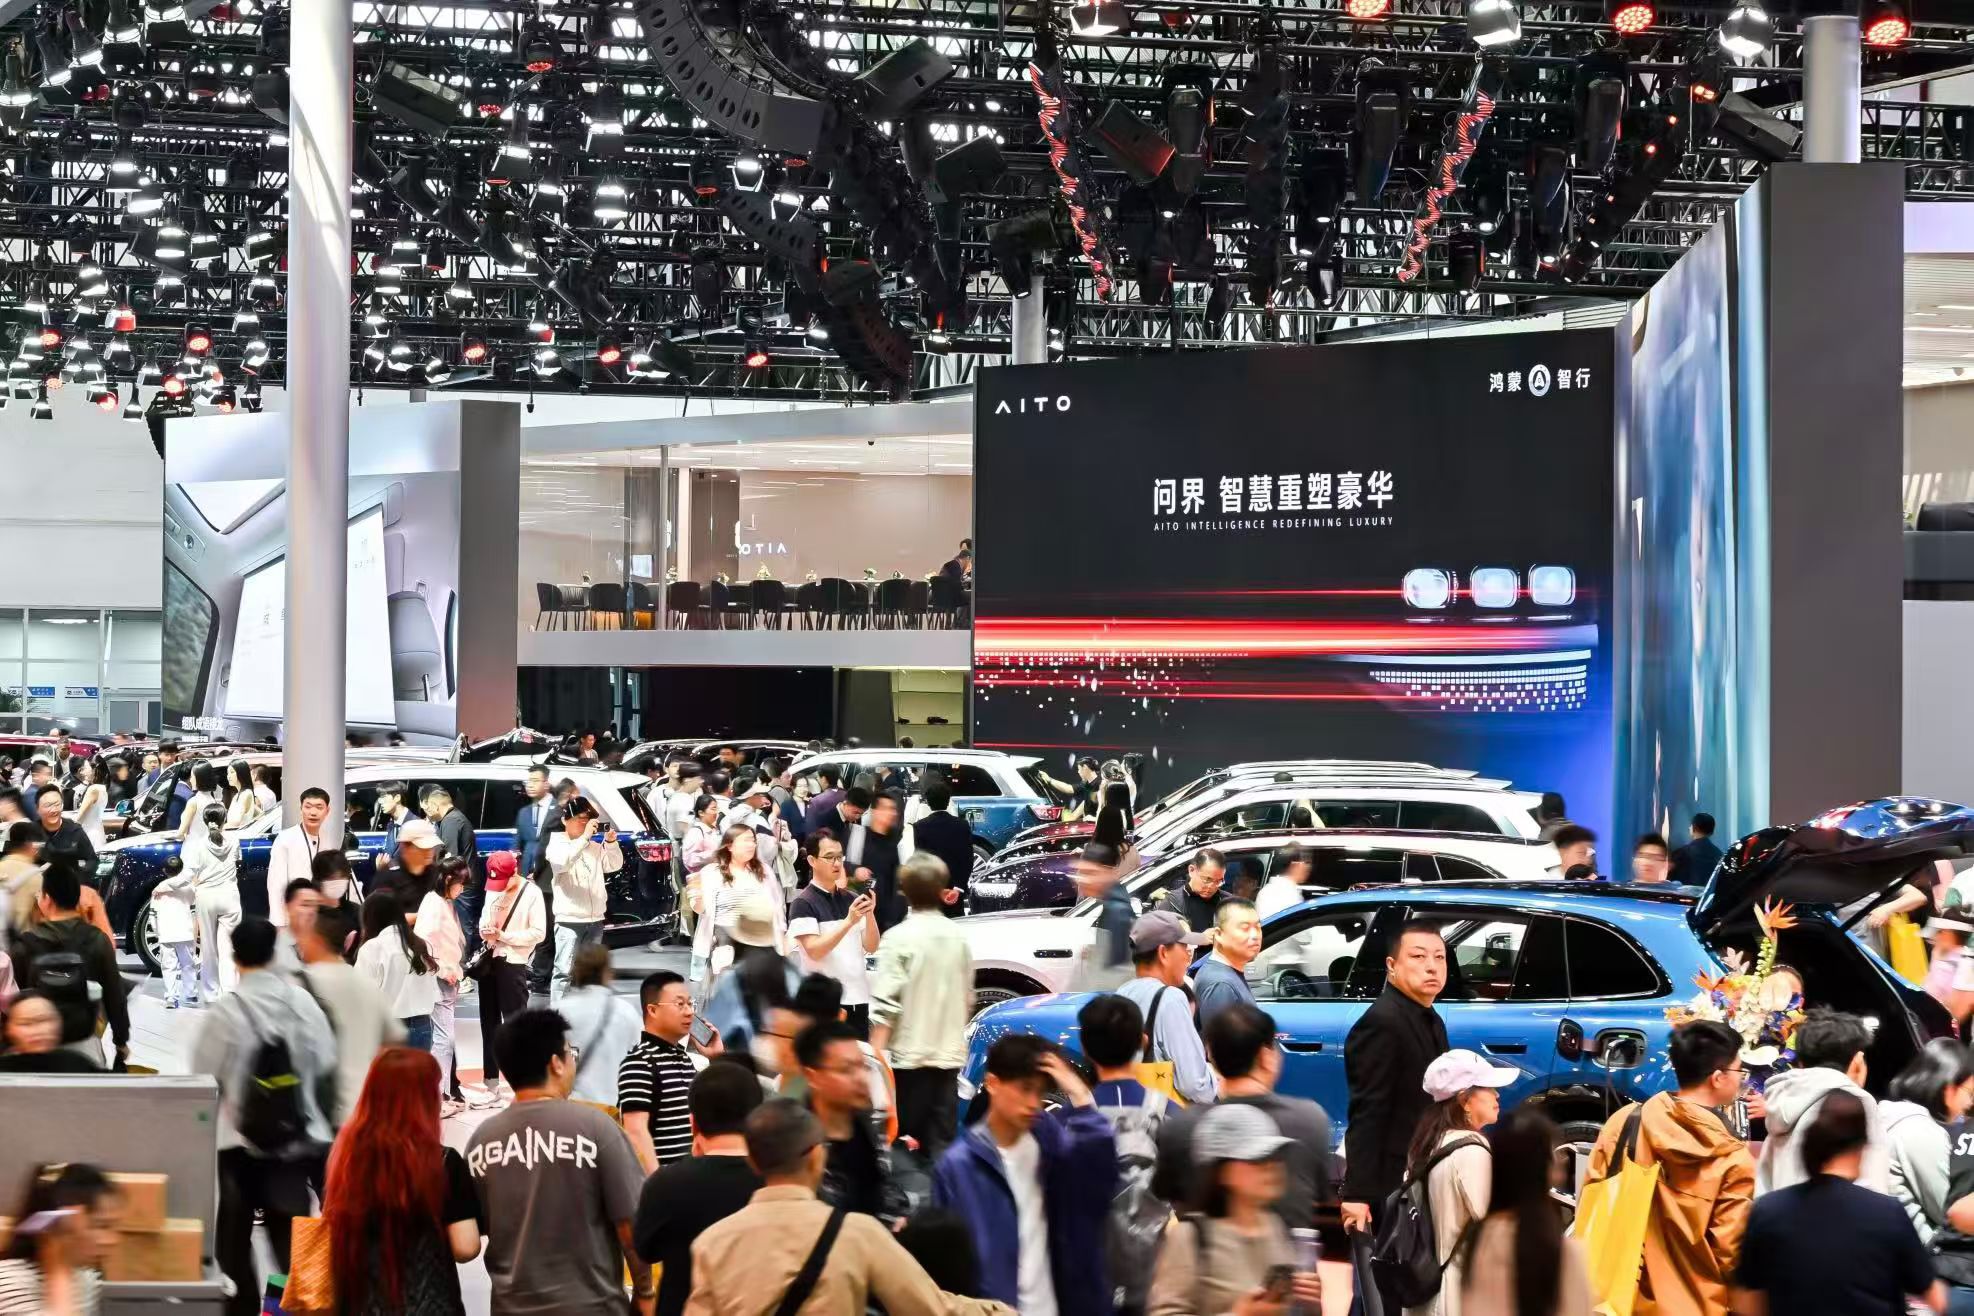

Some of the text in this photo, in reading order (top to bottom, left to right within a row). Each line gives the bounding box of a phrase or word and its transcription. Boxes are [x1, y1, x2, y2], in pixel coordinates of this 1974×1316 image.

[1489, 372, 1522, 393] 鸿蒙
[1557, 367, 1591, 390] 智行
[995, 395, 1071, 414] AITO
[1153, 470, 1393, 515] 问界 智慧重塑豪华
[1153, 516, 1393, 531] AITO INTELLIGENCE REDEFINING LUXURY
